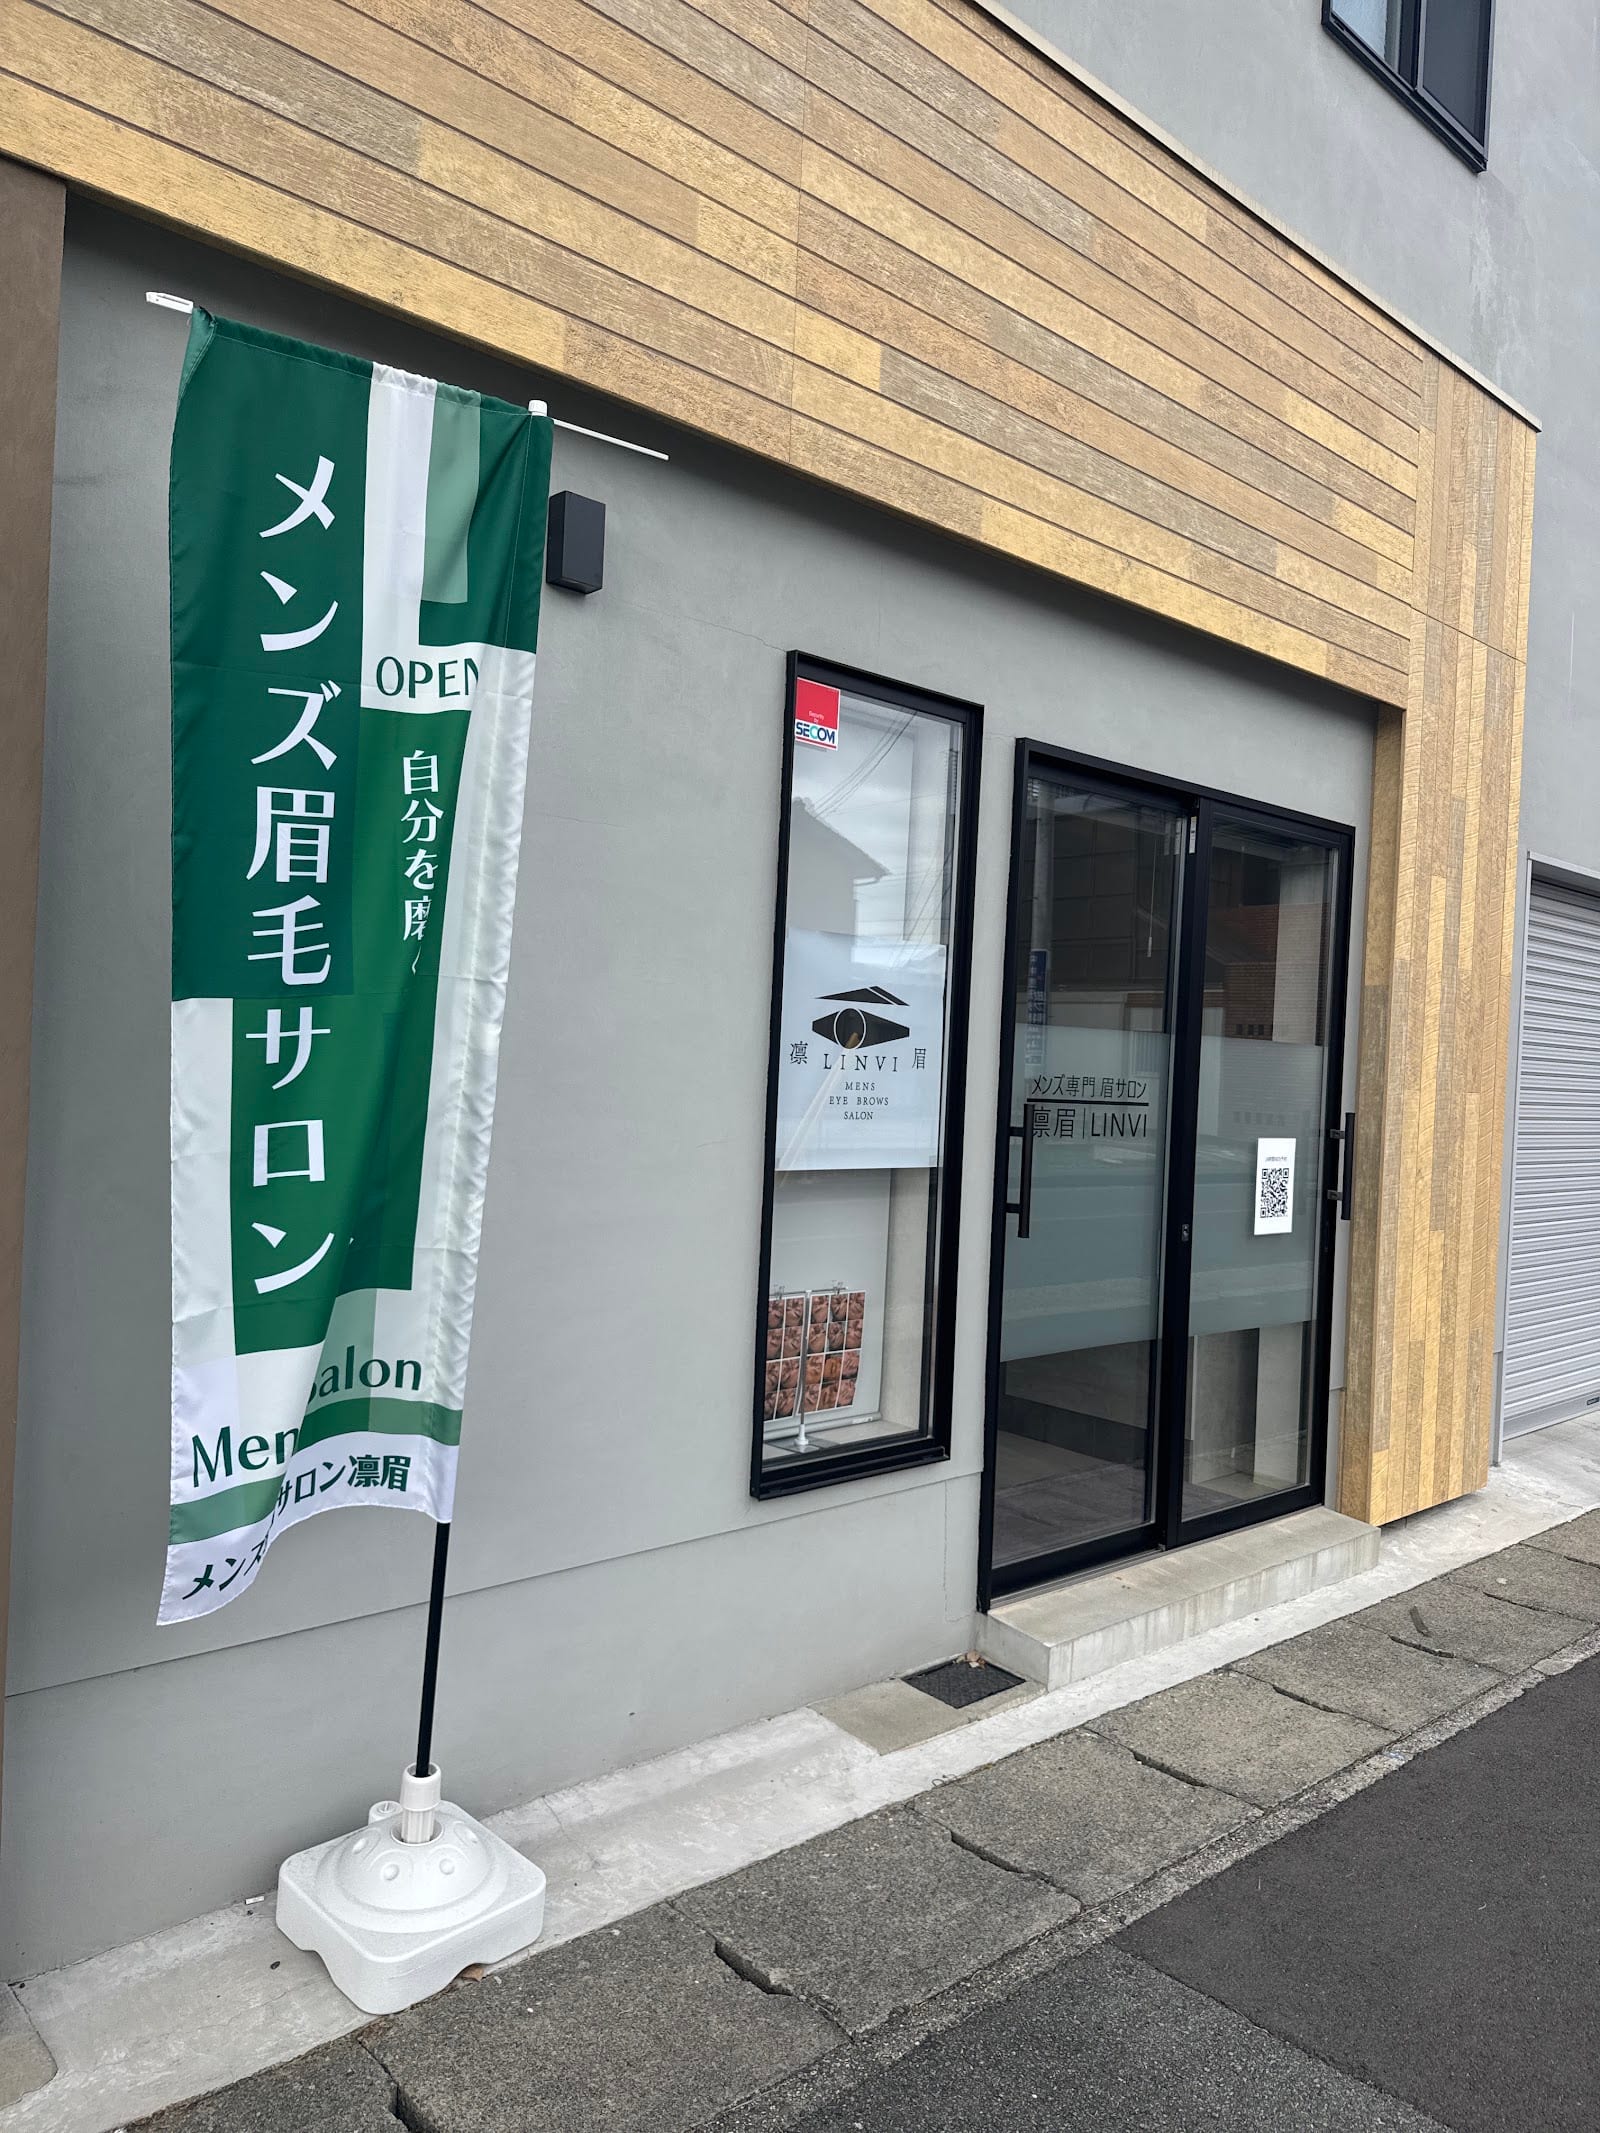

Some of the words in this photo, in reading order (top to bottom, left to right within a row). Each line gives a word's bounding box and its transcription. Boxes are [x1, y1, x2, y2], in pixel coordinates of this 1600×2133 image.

[376, 656, 479, 698] OPEN
[796, 722, 835, 744] SECOM
[246, 455, 341, 1295] メンズ眉毛サロン
[823, 1053, 898, 1072] LINVI
[912, 1047, 927, 1070] 眉
[845, 1082, 876, 1091] MENS
[829, 1096, 848, 1105] EYE
[856, 1097, 889, 1106] BROWS
[843, 1112, 874, 1120] SALON
[1091, 1112, 1147, 1137] LINVI
